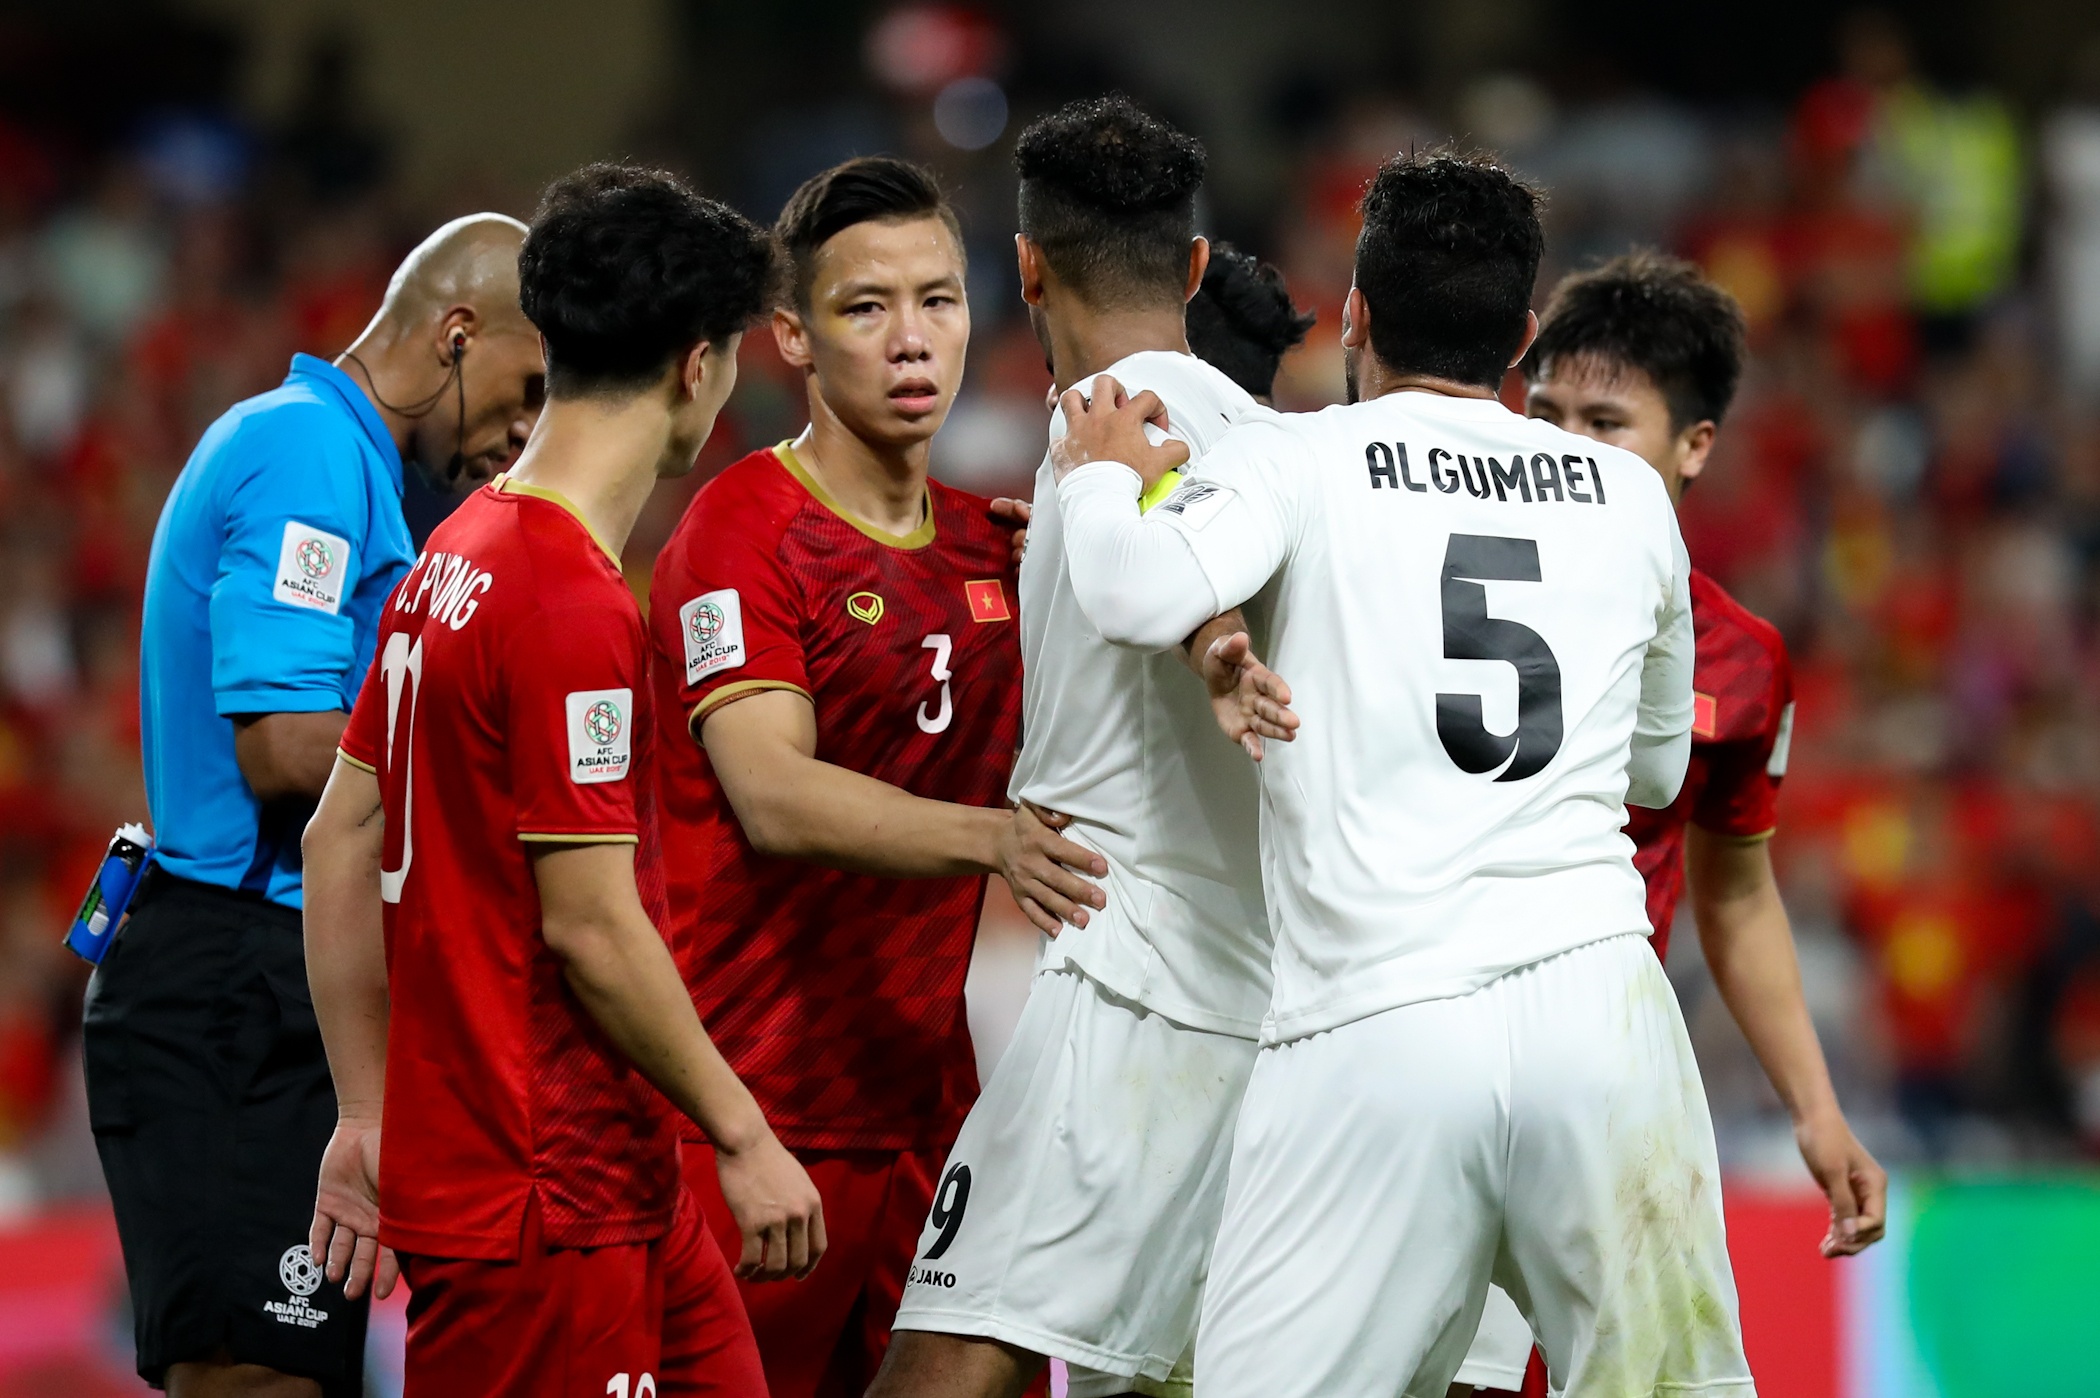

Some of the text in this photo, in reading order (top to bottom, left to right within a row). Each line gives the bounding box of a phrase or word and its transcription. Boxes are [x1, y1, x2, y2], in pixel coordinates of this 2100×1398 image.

[303, 578, 319, 588] AFC
[282, 579, 336, 603] ASIAN CUP
[700, 641, 716, 653] AFC
[689, 644, 739, 669] ASIAN CUP
[1435, 532, 1564, 783] 5
[695, 662, 708, 672] UAE
[916, 633, 953, 734] 3
[597, 747, 614, 756] AFC
[577, 754, 628, 768] ASIAN CUP
[589, 766, 604, 774] UAE
[921, 1161, 972, 1260] 9
[916, 1269, 957, 1289] JAKO
[288, 1294, 310, 1308] AFC
[263, 1300, 329, 1322] ASIAN CUP
[276, 1314, 296, 1324] UAE
